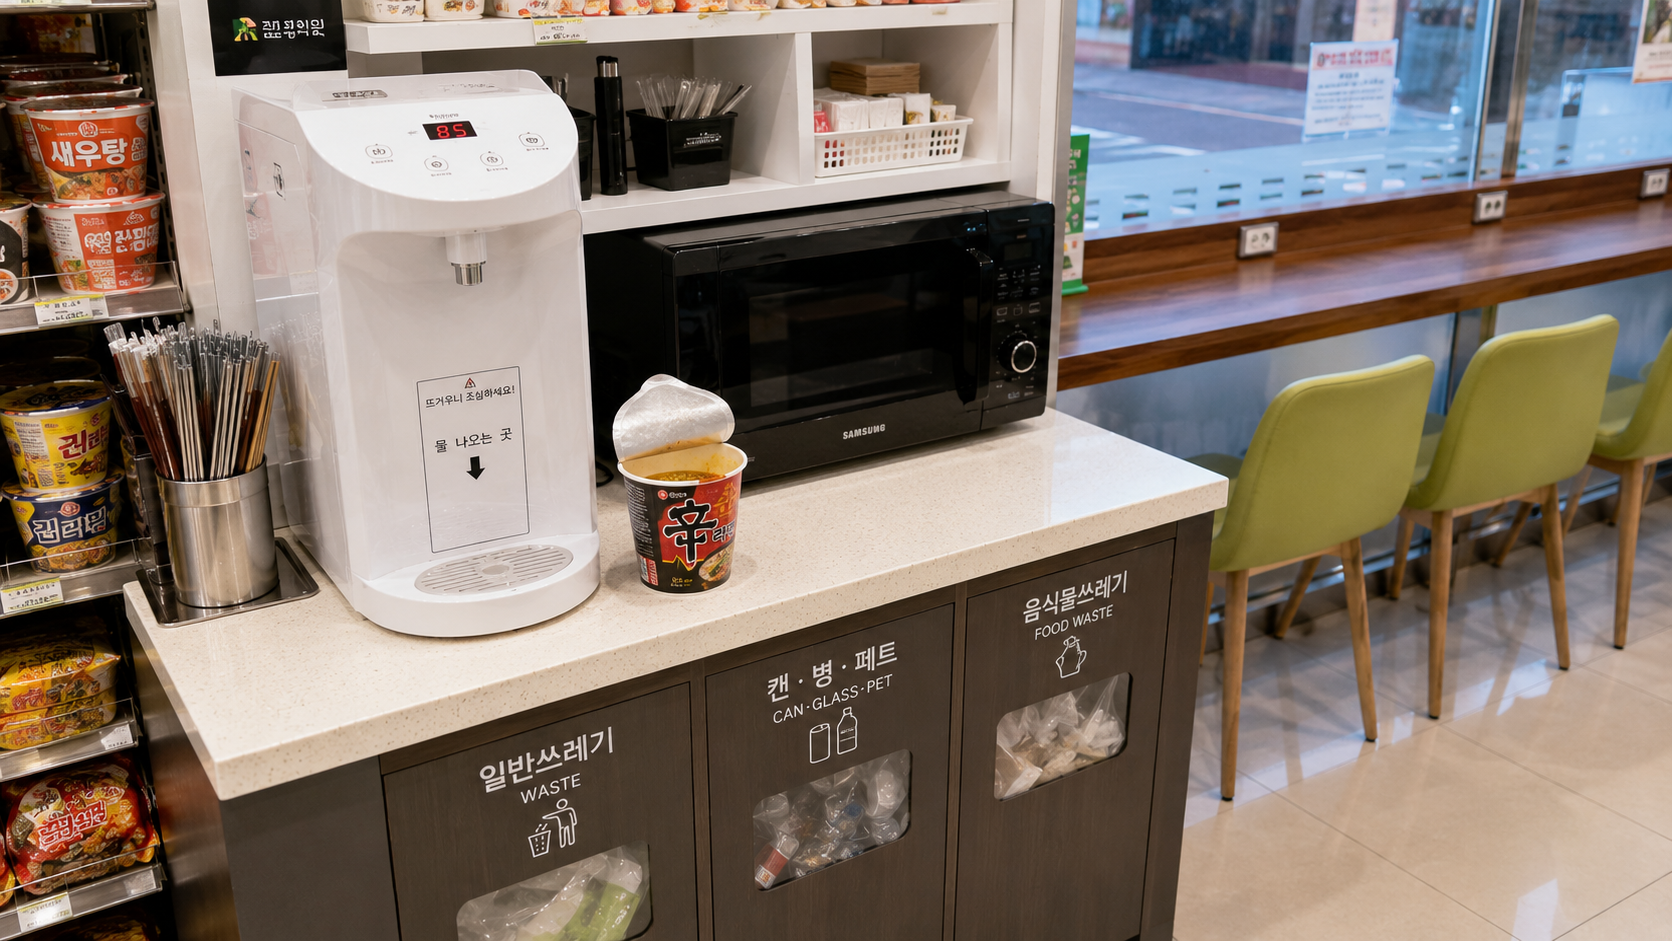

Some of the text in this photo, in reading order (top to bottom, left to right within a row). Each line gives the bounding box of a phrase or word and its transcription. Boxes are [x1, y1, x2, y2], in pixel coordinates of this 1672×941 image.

[436, 123, 467, 139] 85
[51, 138, 128, 168] 새우탕
[426, 385, 515, 408] 뜨거우니 조심하세요!
[434, 428, 512, 453] 물 나오는 곳
[843, 424, 886, 440] SAMSUNG
[663, 498, 719, 564] 辛
[1023, 570, 1128, 624] 음식물쓰레기
[1035, 604, 1114, 641] FOOD WASTE
[854, 641, 898, 671] 페트
[479, 726, 614, 793] 일반쓰레기
[520, 773, 582, 804] WASTE
